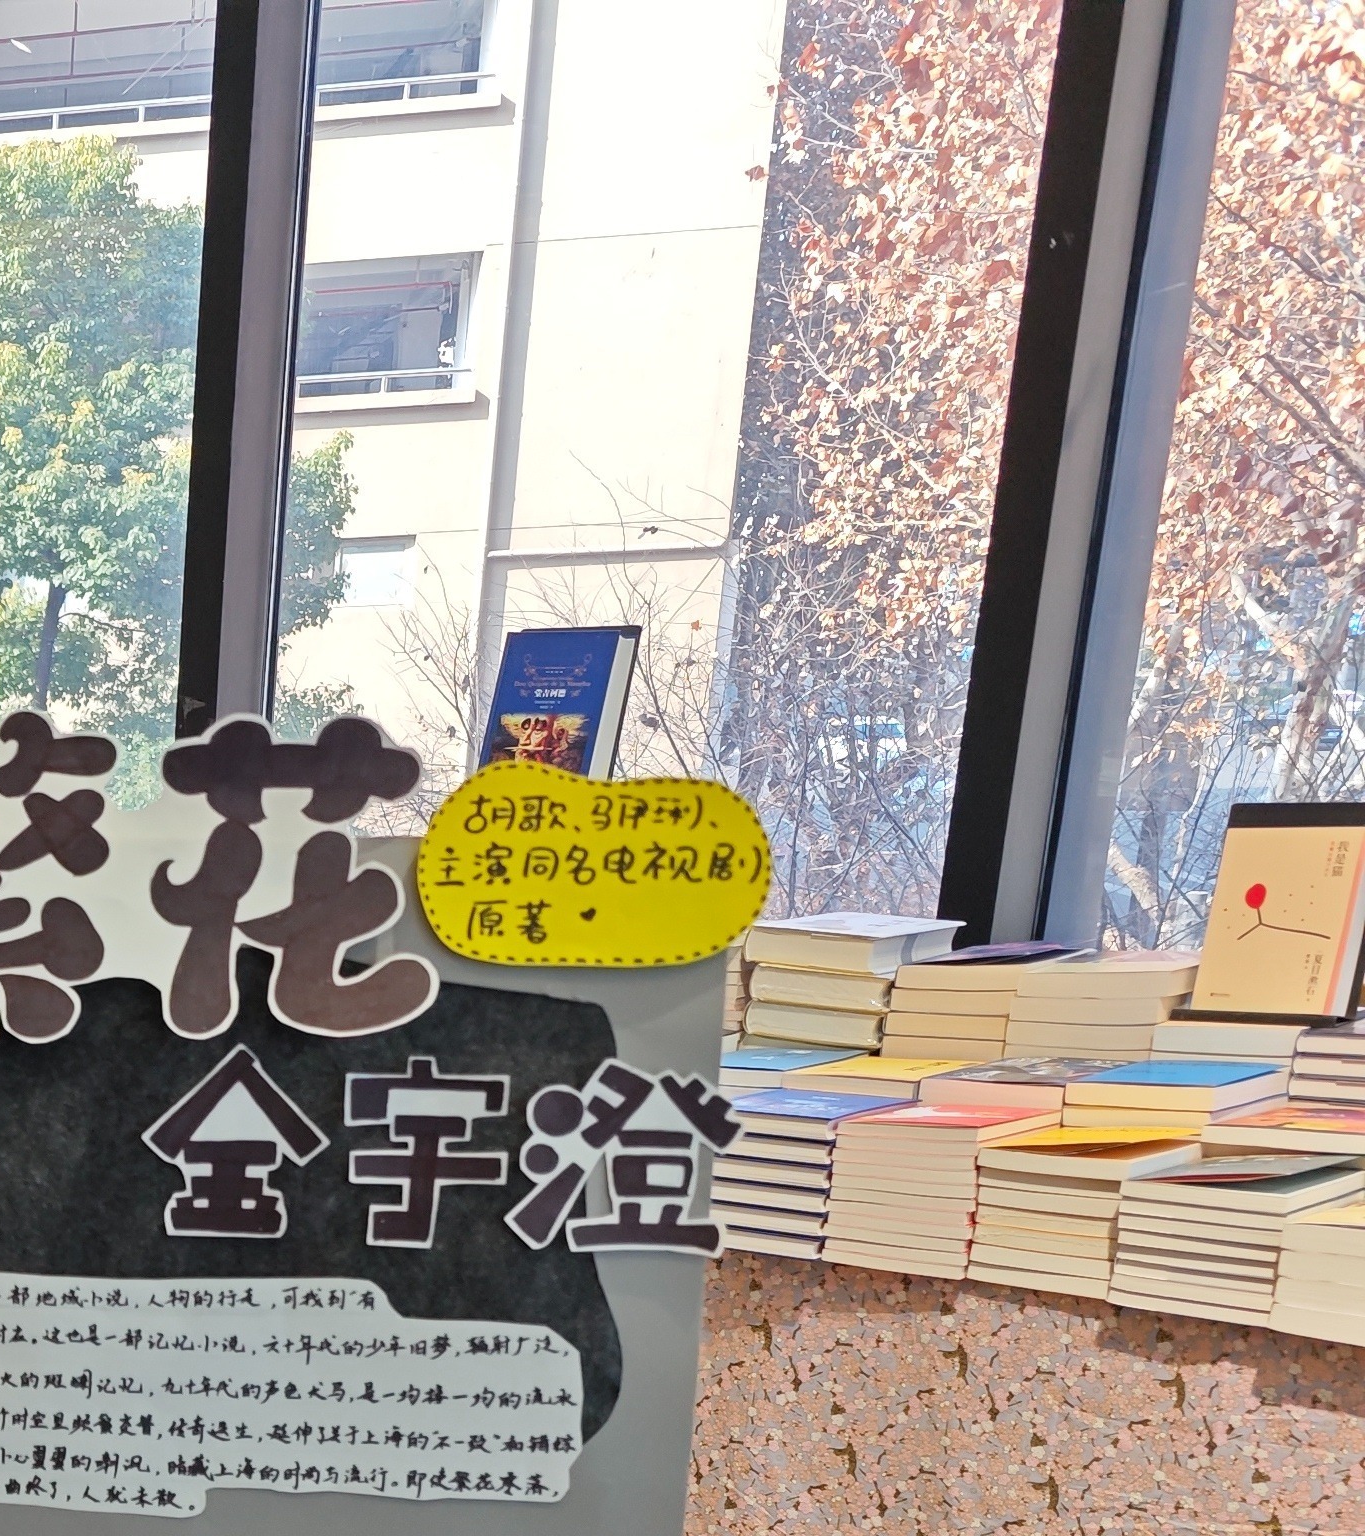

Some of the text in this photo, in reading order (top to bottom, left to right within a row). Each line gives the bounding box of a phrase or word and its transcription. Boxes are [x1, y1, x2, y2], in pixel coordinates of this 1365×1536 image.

[467, 899, 552, 944] 原著
[143, 1045, 739, 1256] 金宇澄
